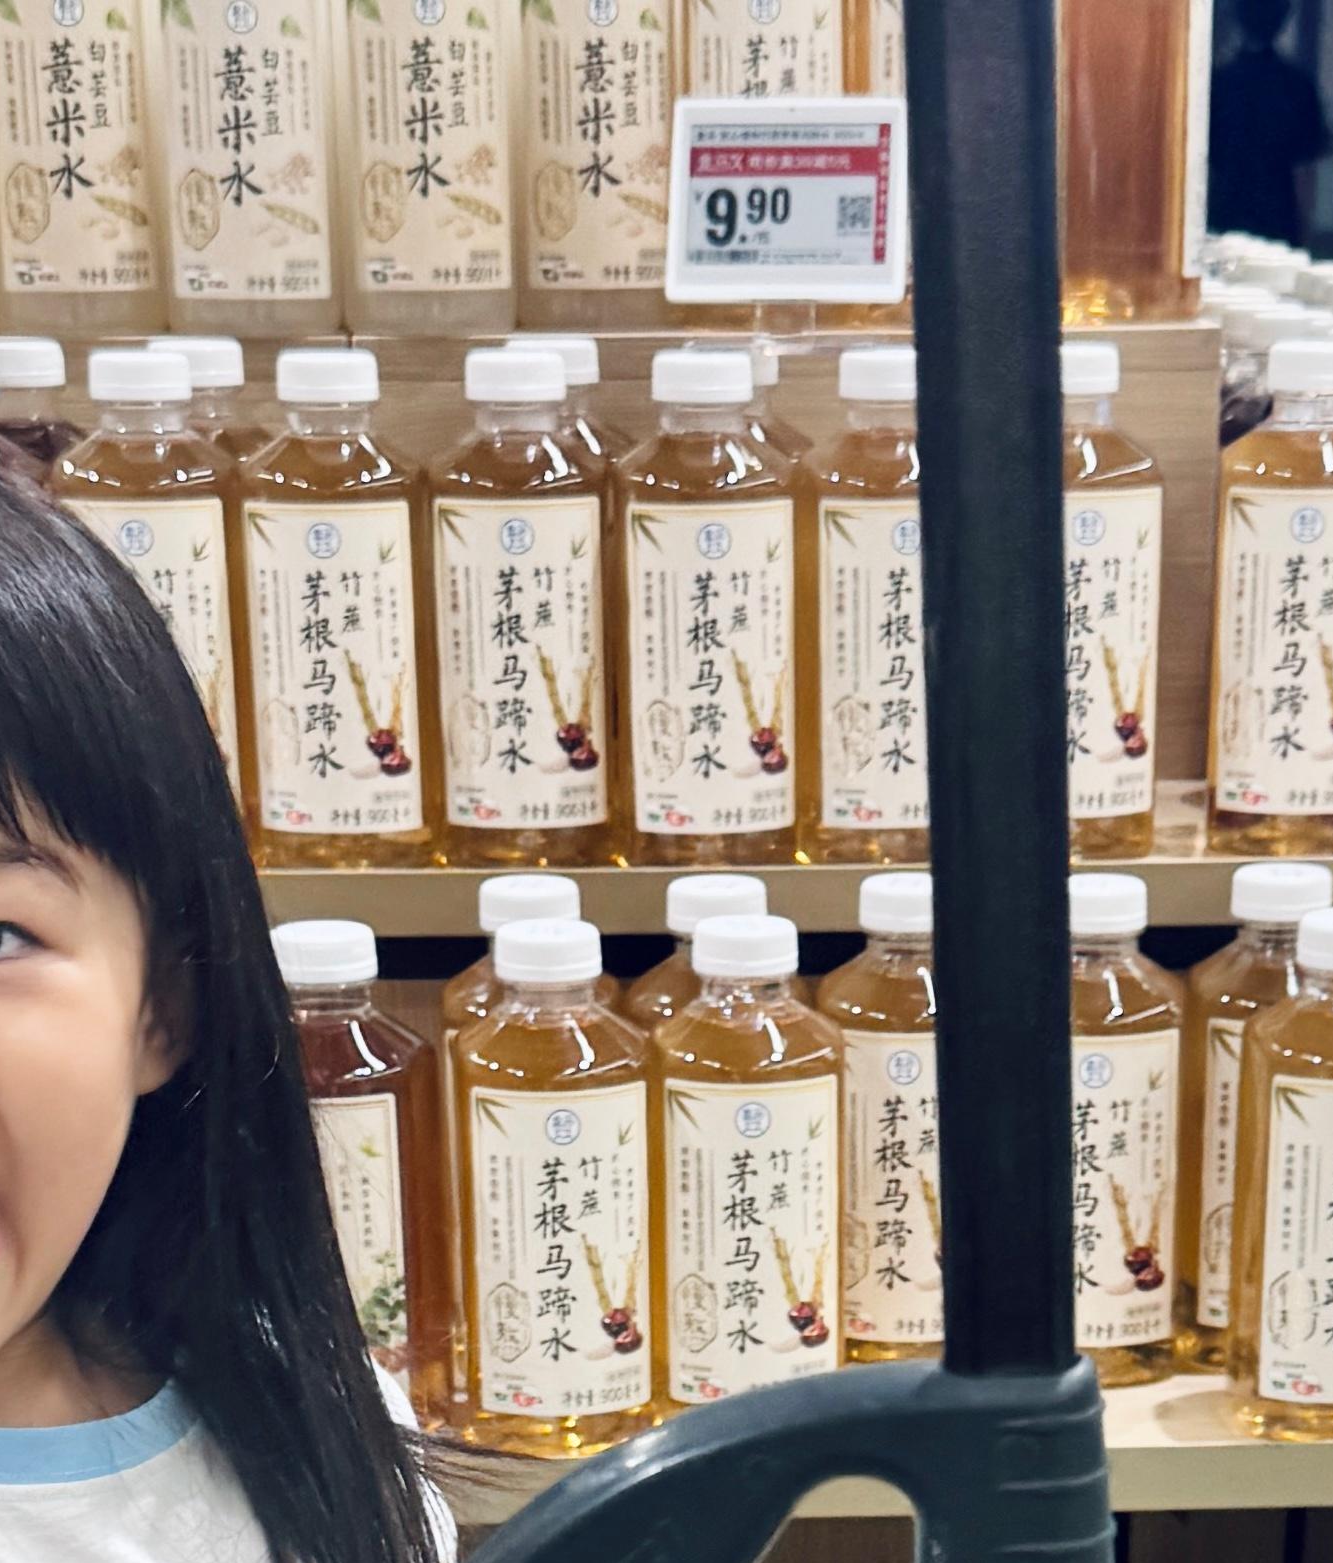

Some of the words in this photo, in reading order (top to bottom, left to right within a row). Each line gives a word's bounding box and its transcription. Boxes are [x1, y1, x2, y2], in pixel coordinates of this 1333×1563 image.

[42, 39, 94, 199] 薏米水
[215, 45, 267, 207] 薏米水
[402, 37, 451, 199] 薏米水
[575, 38, 623, 198] 薏米水
[299, 571, 344, 779] 茅根马蹄水
[490, 565, 534, 776] 茅根马蹄水
[685, 571, 728, 779] 茅根马蹄水
[877, 567, 918, 774] 茅根马蹄水
[1269, 555, 1311, 760] 茅根马蹄水
[533, 1158, 577, 1362] 茅根马蹄水
[722, 1151, 765, 1353] 茅根马蹄水
[875, 1097, 914, 1291] 茅根马蹄水
